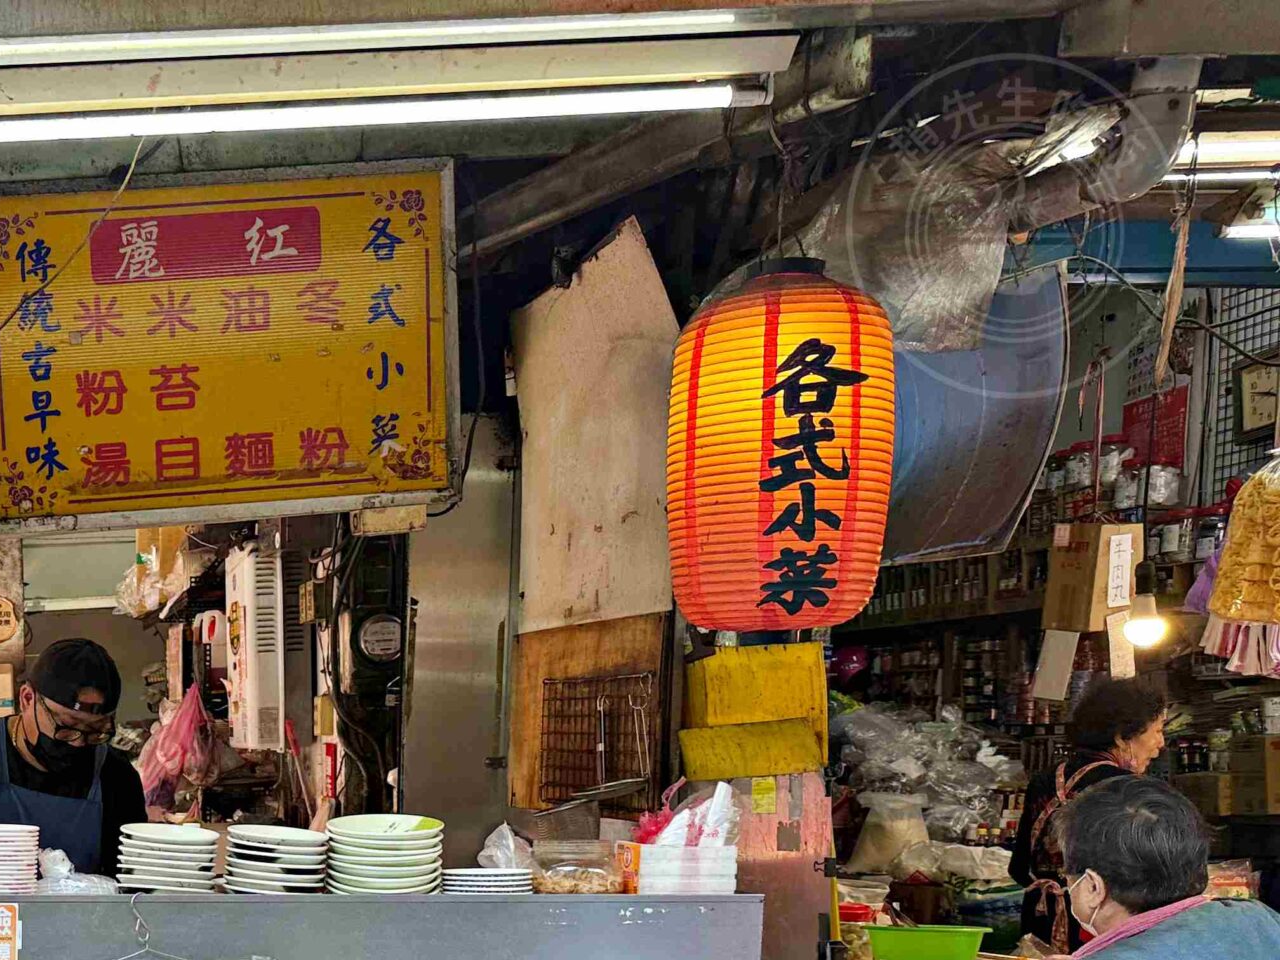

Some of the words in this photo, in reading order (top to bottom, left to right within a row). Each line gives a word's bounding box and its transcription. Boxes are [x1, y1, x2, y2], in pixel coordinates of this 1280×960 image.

[16, 240, 69, 481] 傳統古早味
[72, 293, 131, 489] 米粉湯
[146, 291, 202, 482] 米苔目
[362, 216, 406, 456] 各式小菜
[757, 338, 869, 615] 各式小菜
